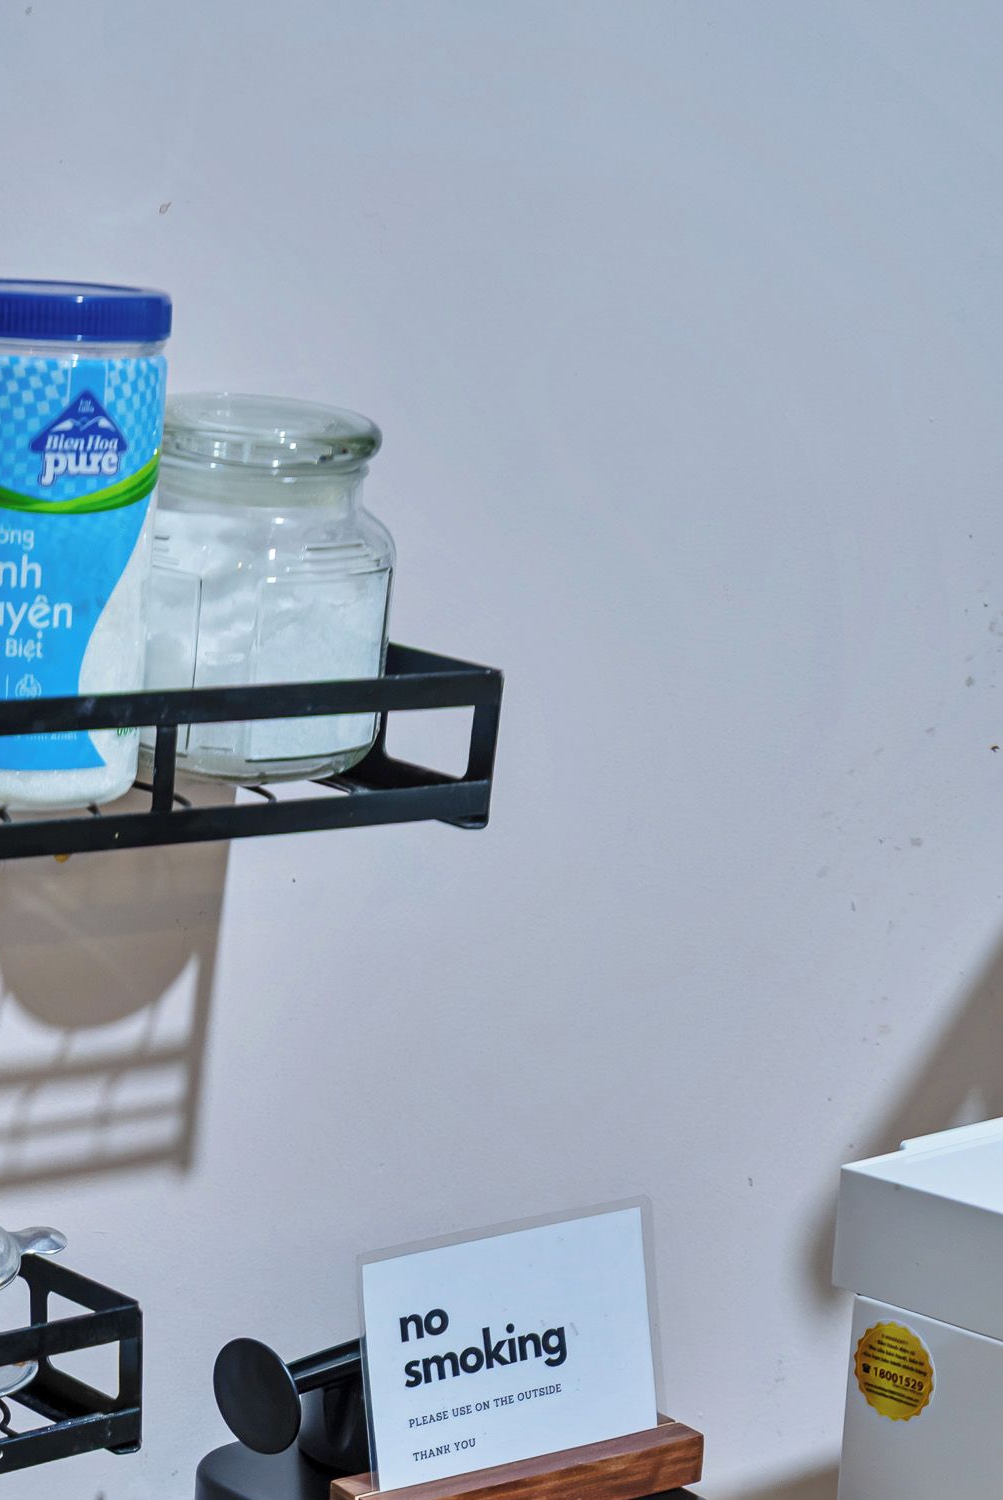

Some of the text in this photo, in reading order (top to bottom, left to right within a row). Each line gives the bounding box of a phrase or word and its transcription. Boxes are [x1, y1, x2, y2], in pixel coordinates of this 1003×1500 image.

[41, 450, 119, 486] pure
[399, 1308, 450, 1343] no
[404, 1322, 568, 1388] smoking
[408, 1383, 563, 1428] PLEASE USE ON THE OUTSIDE
[413, 1438, 477, 1462] THANK YOU
